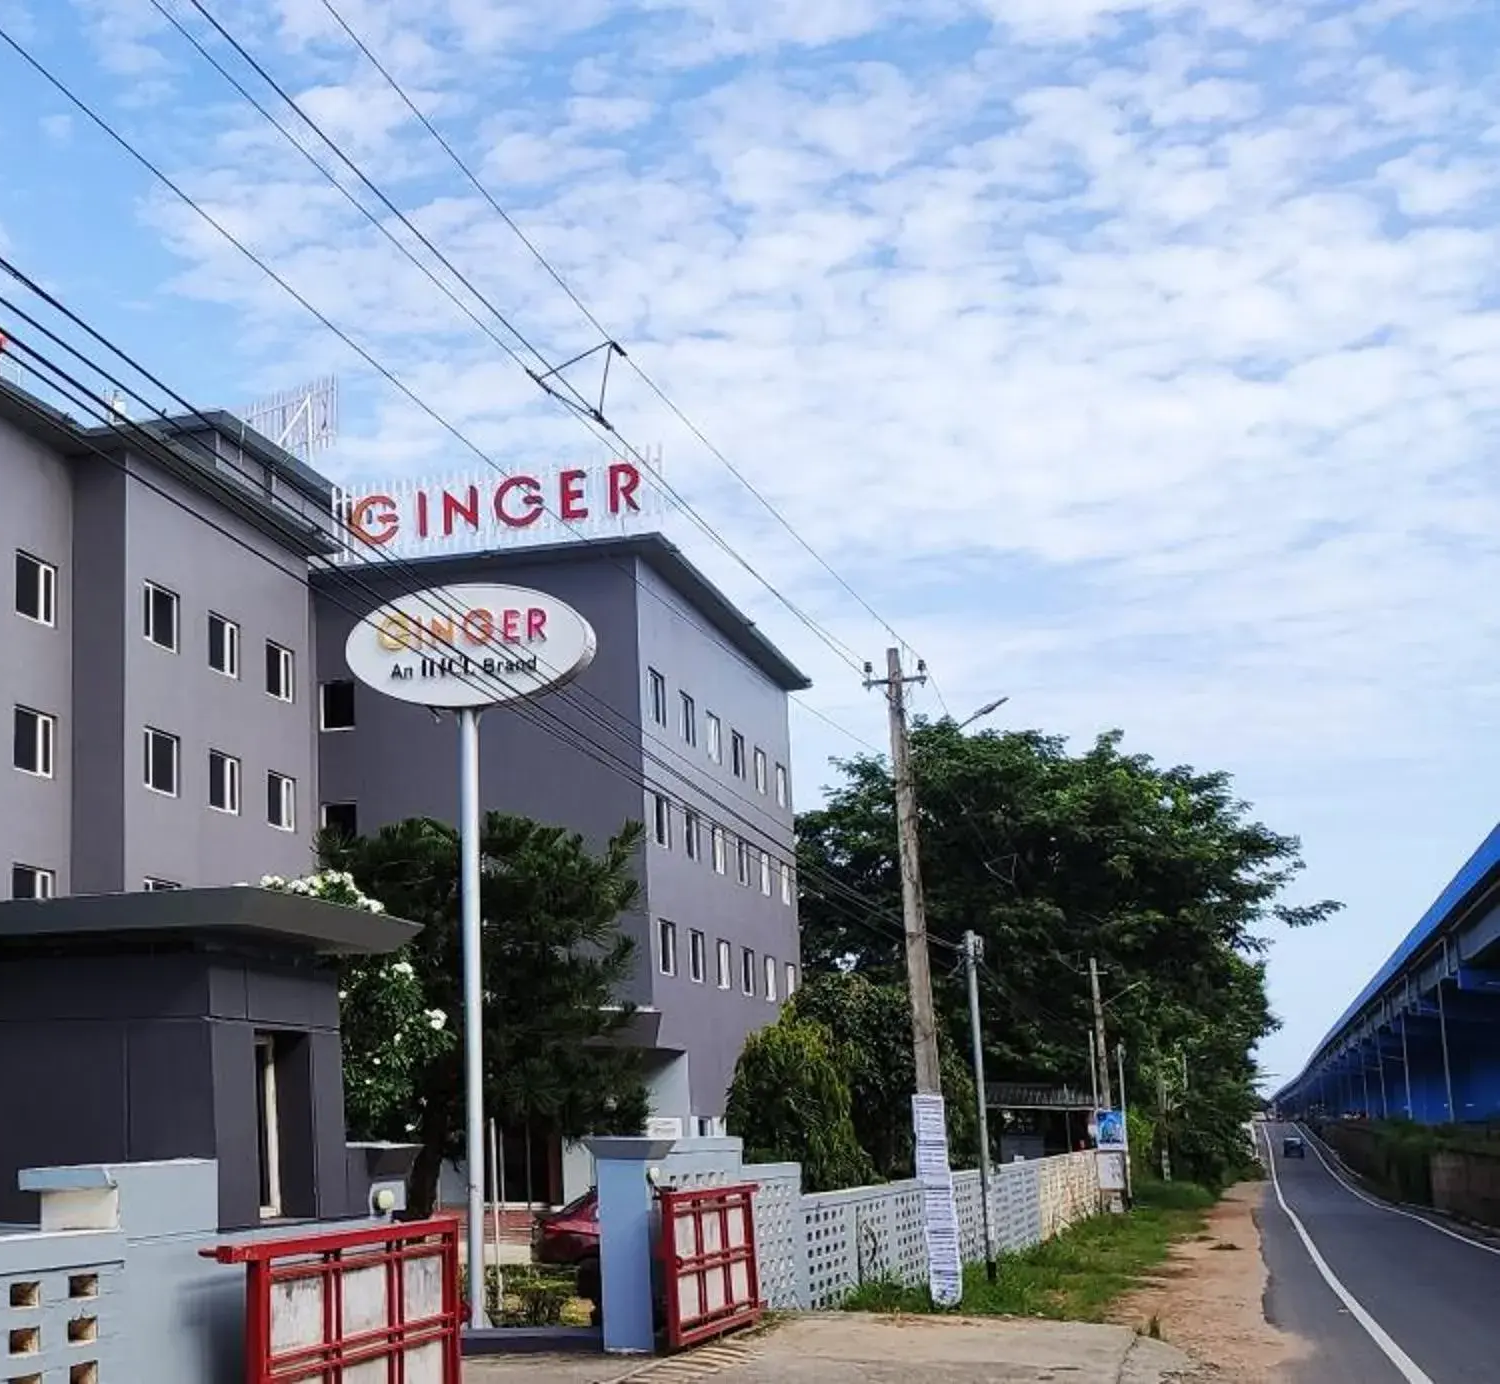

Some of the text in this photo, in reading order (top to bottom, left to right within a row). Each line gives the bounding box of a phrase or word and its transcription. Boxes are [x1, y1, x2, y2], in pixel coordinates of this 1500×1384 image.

[348, 463, 641, 544] GINGER
[378, 608, 547, 650] GINGER
[390, 662, 413, 679] An
[483, 655, 537, 674] Brand
